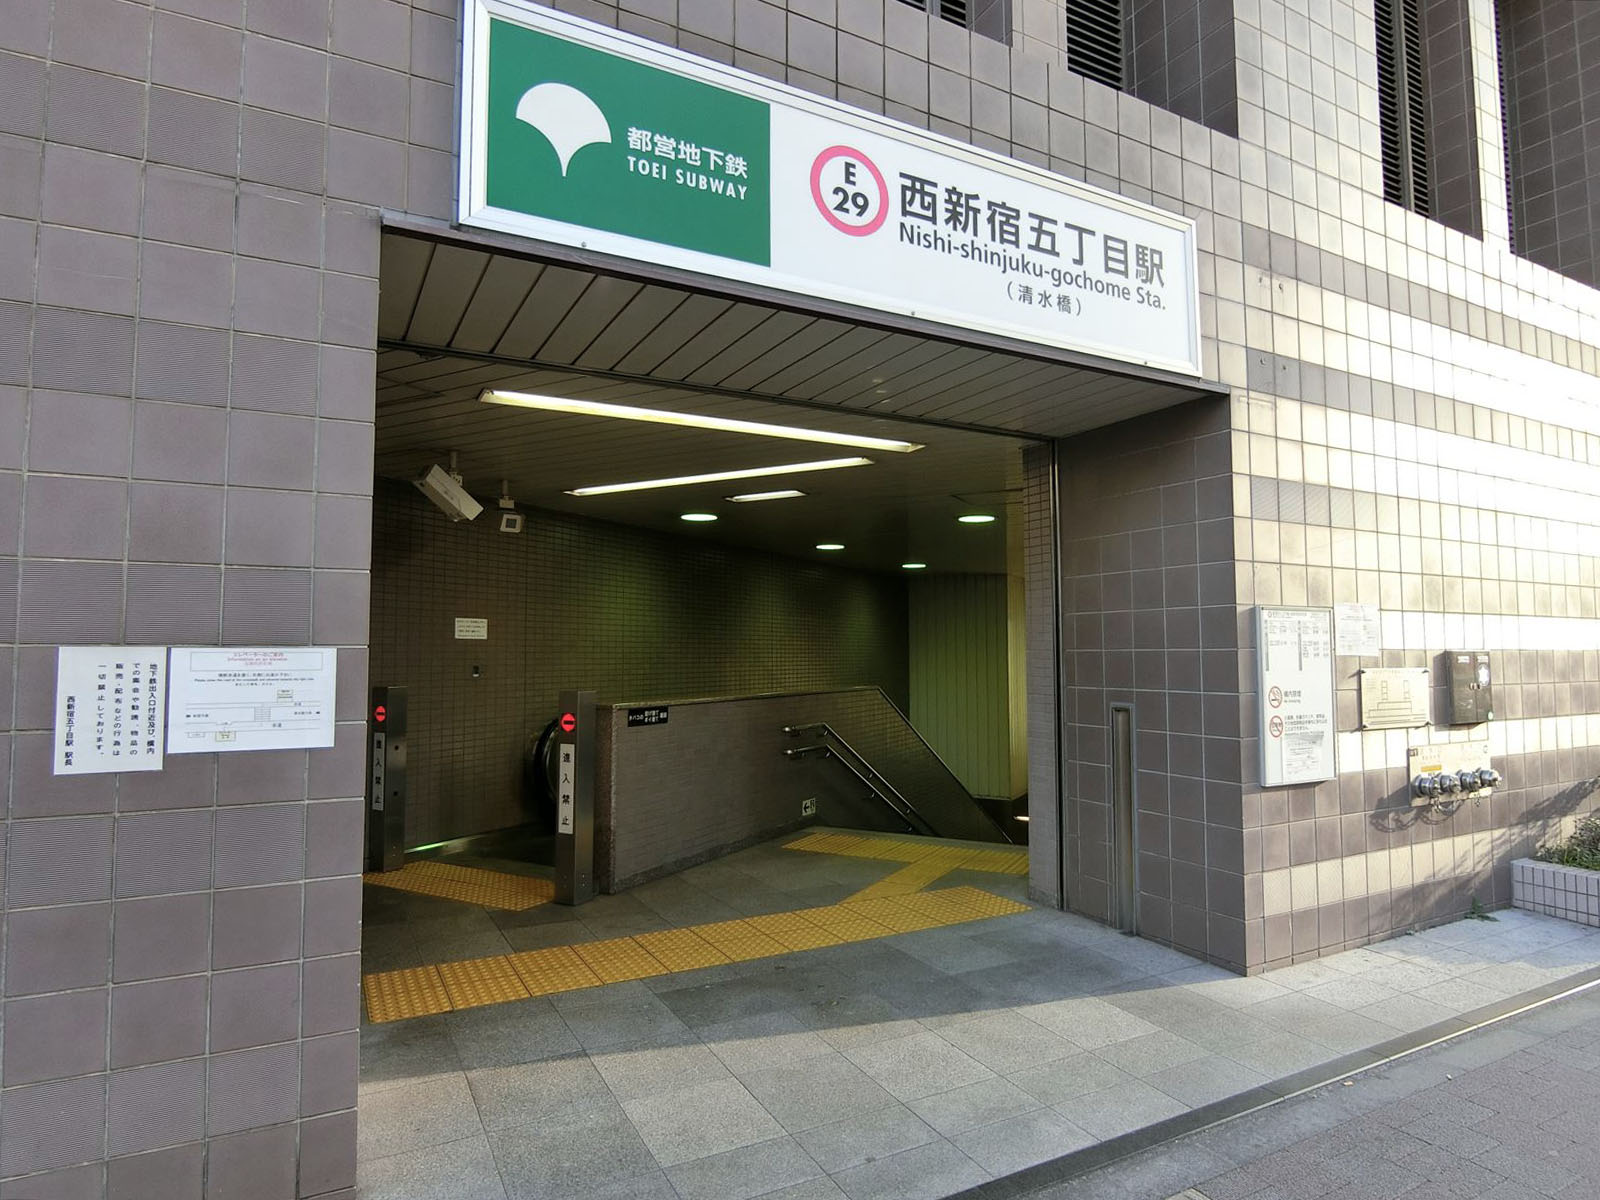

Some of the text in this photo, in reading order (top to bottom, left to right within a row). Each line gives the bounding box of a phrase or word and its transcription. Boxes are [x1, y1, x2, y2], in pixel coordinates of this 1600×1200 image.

[627, 127, 748, 179] 都営地下鉄
[627, 156, 748, 200] TOEI SUBWAY
[844, 161, 857, 187] E
[832, 186, 870, 217] 29
[899, 171, 1165, 288] 西新宿五丁目駅
[900, 222, 1167, 310] Nishi-shinjuku-gochome Sta.
[562, 753, 570, 826] 進入禁止
